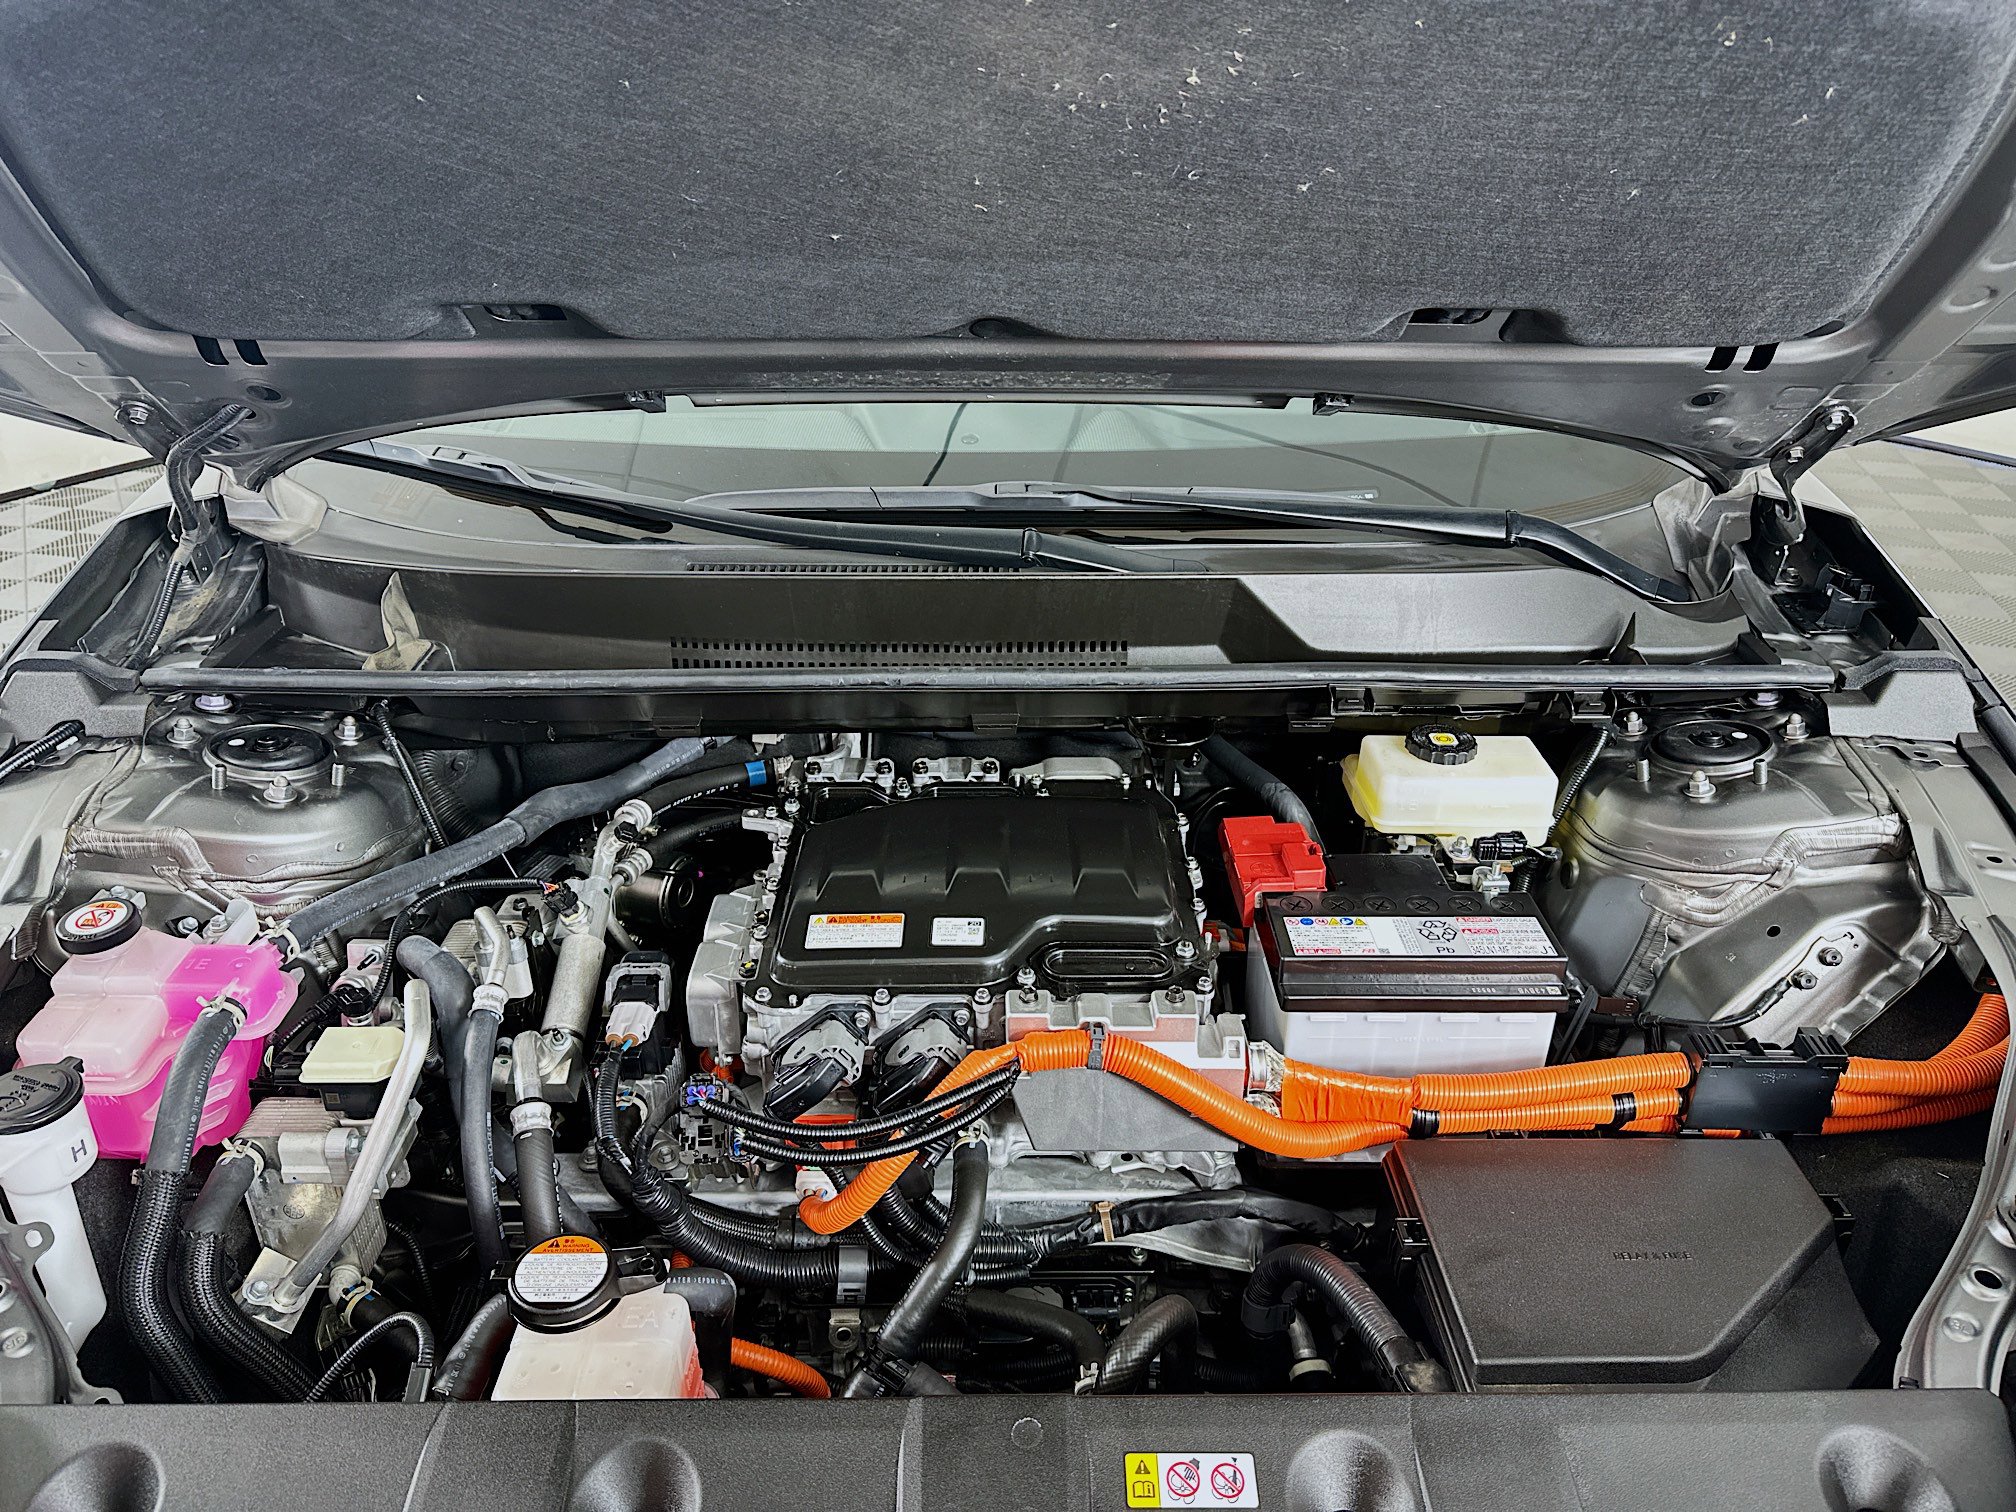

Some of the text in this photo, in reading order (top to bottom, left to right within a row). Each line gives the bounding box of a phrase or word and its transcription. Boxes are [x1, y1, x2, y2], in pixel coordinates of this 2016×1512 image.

[1435, 946, 1456, 954] Pb
[71, 1138, 88, 1162] H
[1612, 1251, 1648, 1260] RELAY
[1662, 1250, 1694, 1260] FUSE
[666, 1276, 691, 1284] WATER
